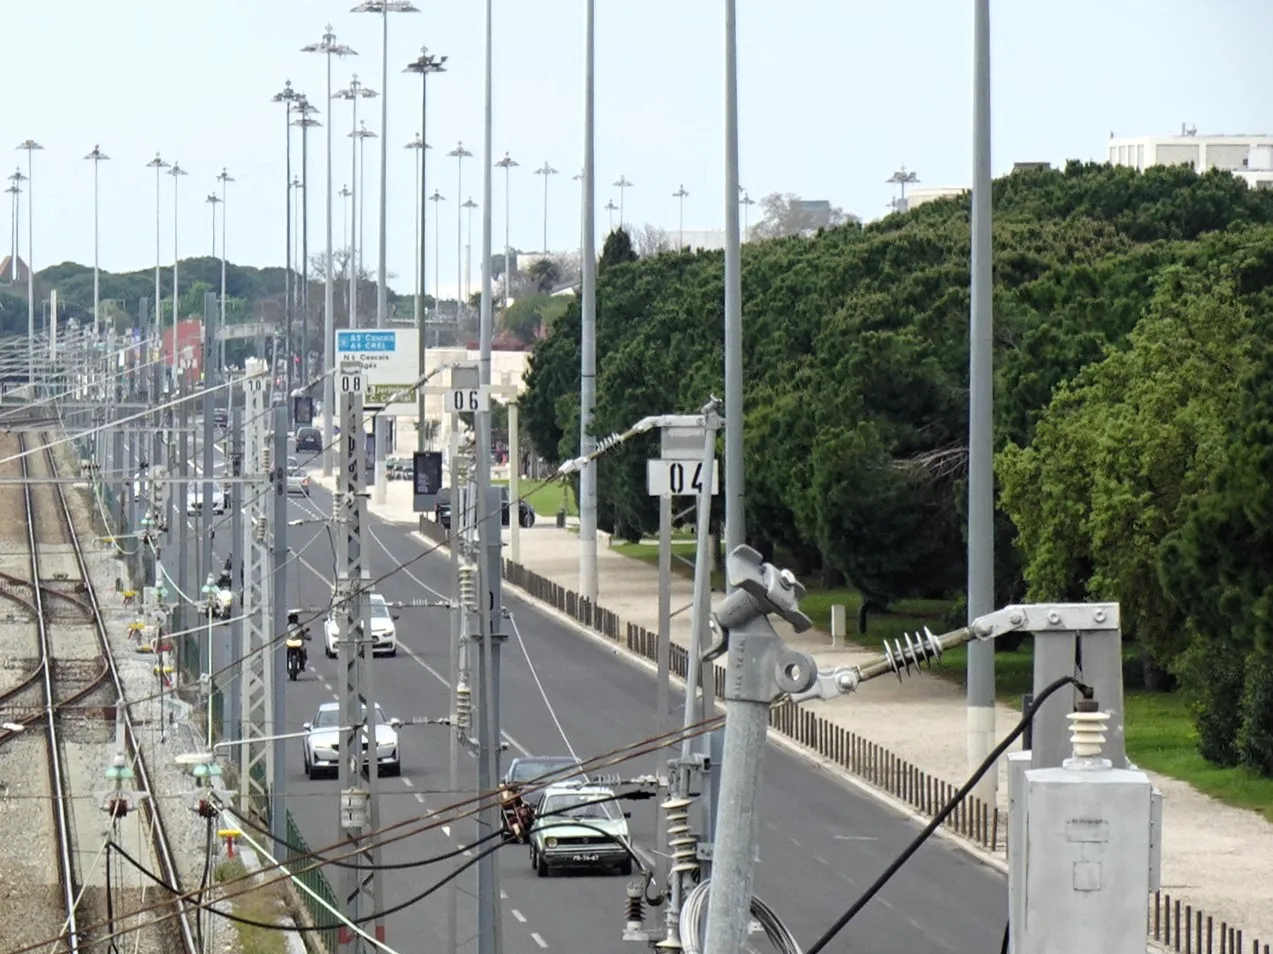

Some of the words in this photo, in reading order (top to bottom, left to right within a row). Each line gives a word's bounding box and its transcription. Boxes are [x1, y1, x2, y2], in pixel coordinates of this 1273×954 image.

[342, 376, 361, 392] 08
[454, 391, 478, 410] 06
[670, 462, 702, 494] 04
